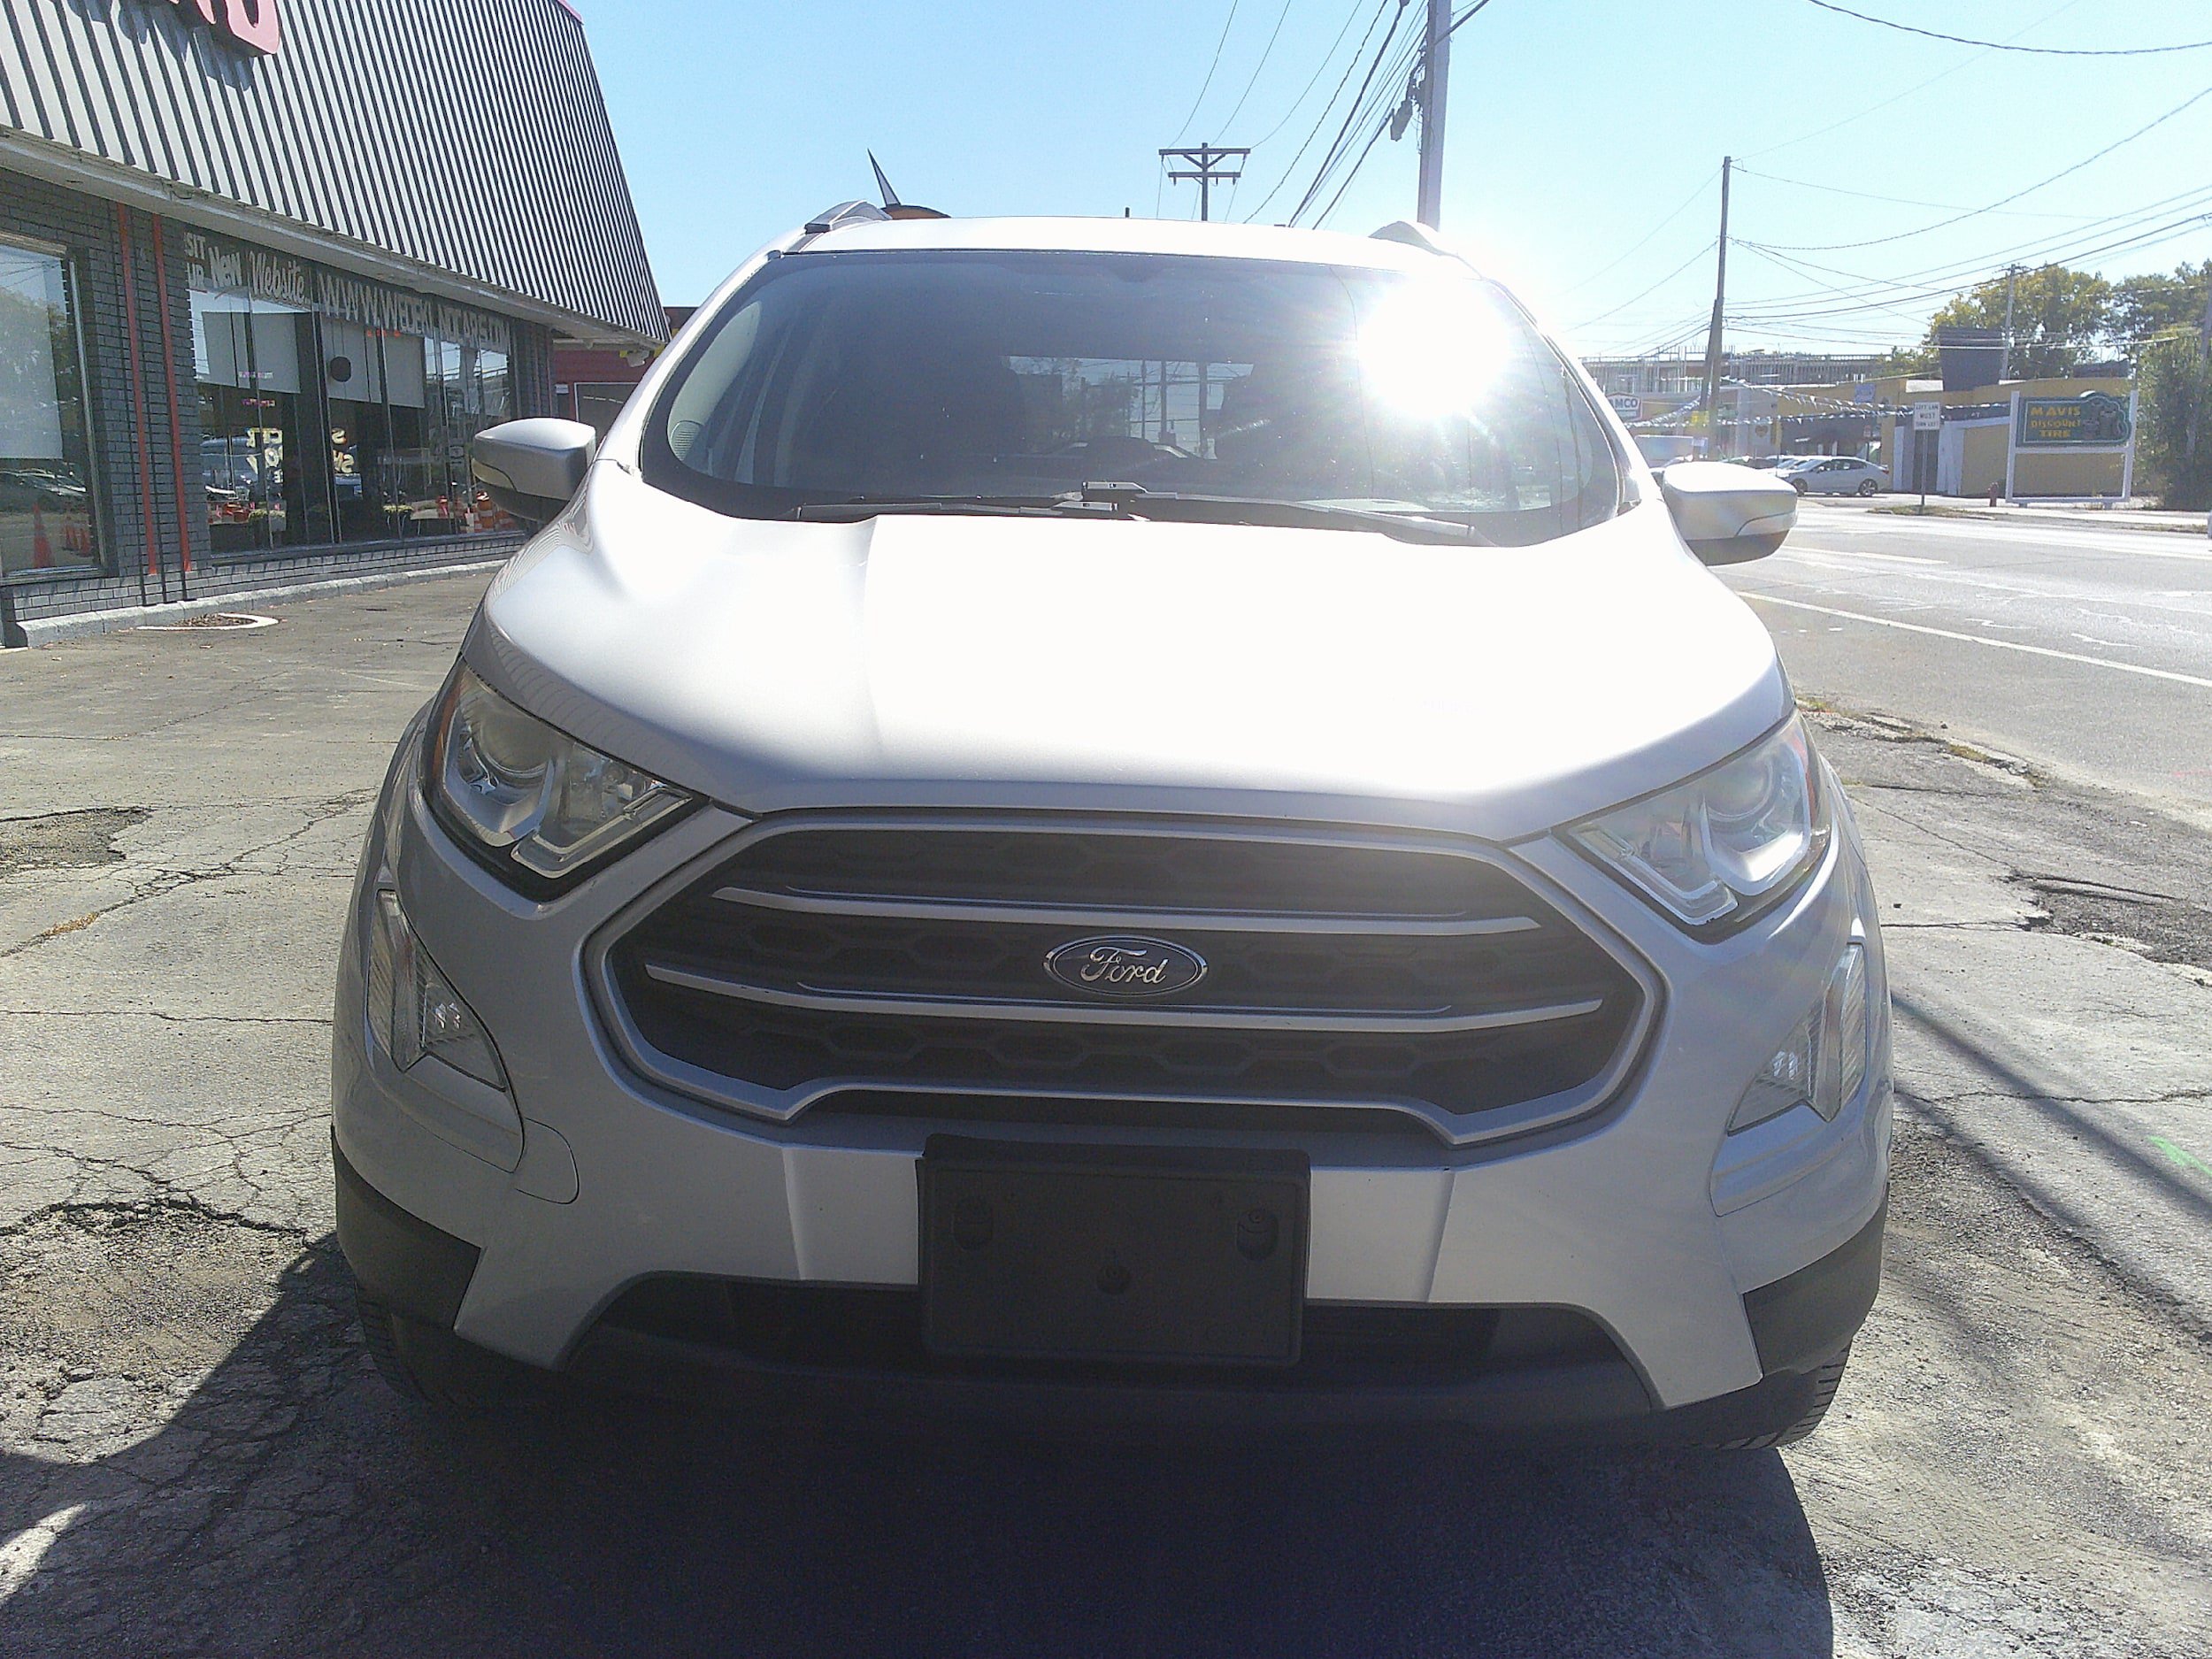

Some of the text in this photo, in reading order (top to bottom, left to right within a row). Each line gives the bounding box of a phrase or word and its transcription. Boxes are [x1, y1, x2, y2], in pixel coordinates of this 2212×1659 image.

[2030, 406, 2081, 417] MAVIS
[2030, 419, 2081, 428] DISCOUNT
[2039, 429, 2071, 438] TIRE
[1080, 946, 1168, 984] Ford
